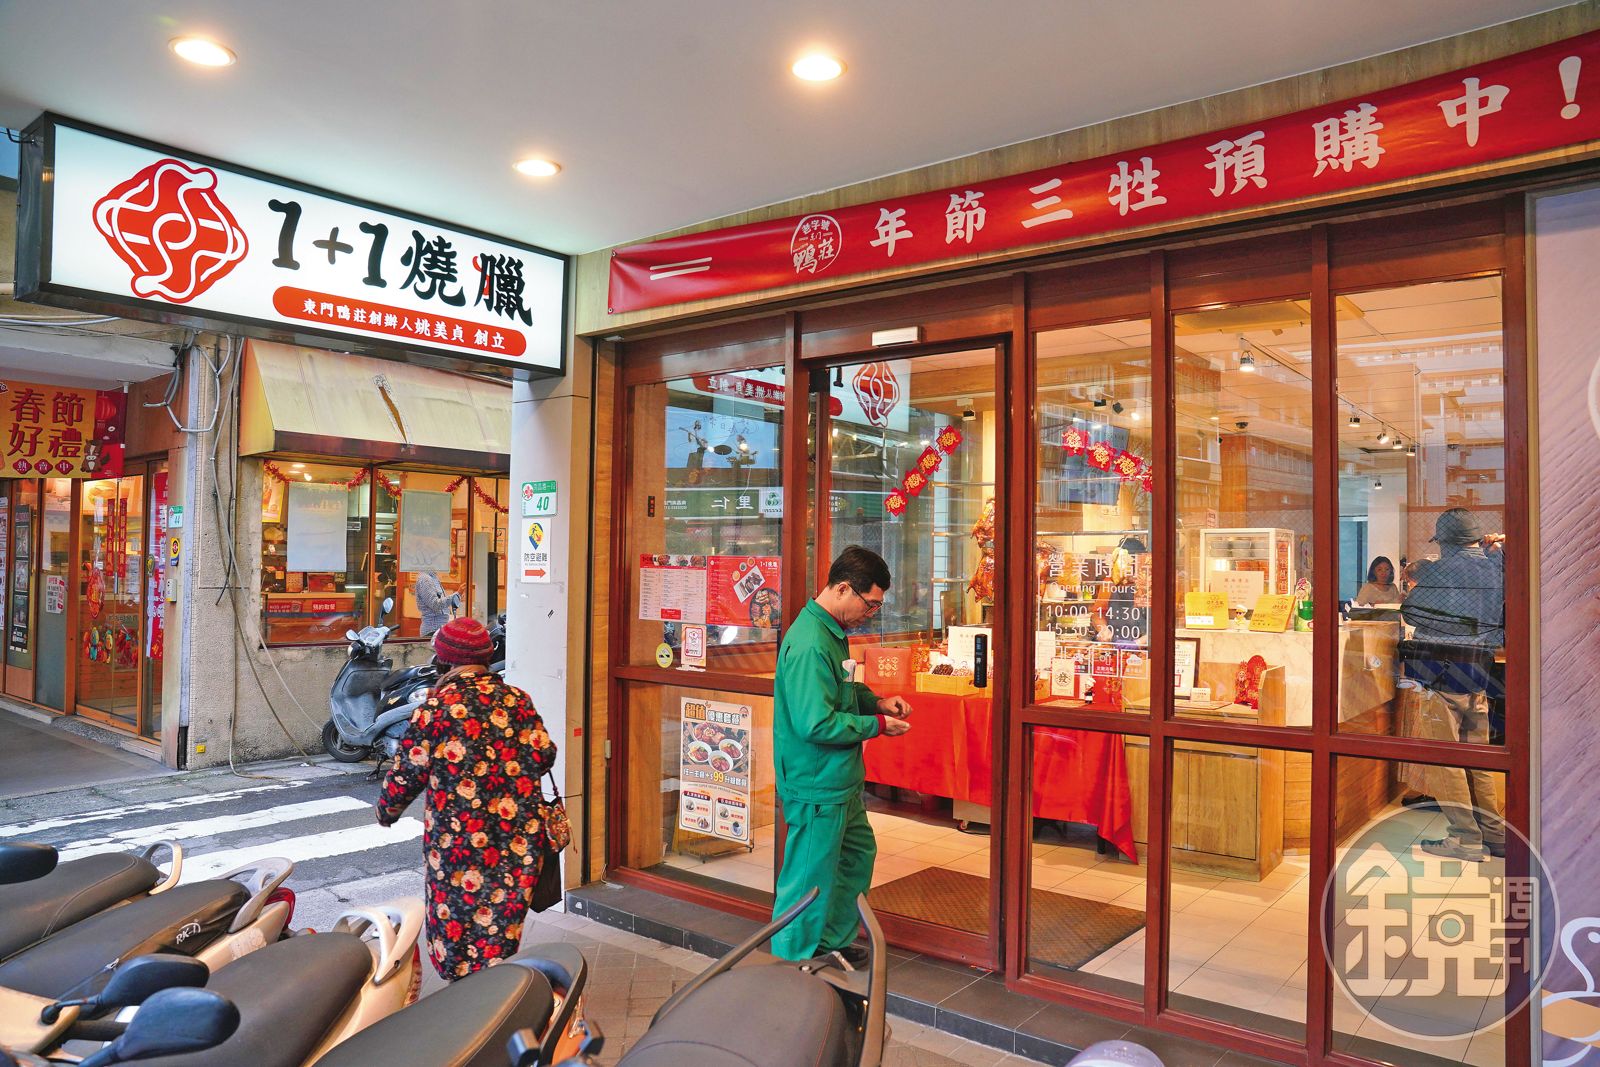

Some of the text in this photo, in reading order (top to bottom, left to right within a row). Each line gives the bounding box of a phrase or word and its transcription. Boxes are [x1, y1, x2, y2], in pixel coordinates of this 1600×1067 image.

[473, 328, 506, 350] 創立
[10, 388, 85, 426] 春節
[7, 423, 83, 458] 好禮
[536, 496, 550, 511] 40
[1048, 552, 1138, 578] 營業時間
[1050, 582, 1137, 595] Opening Hours
